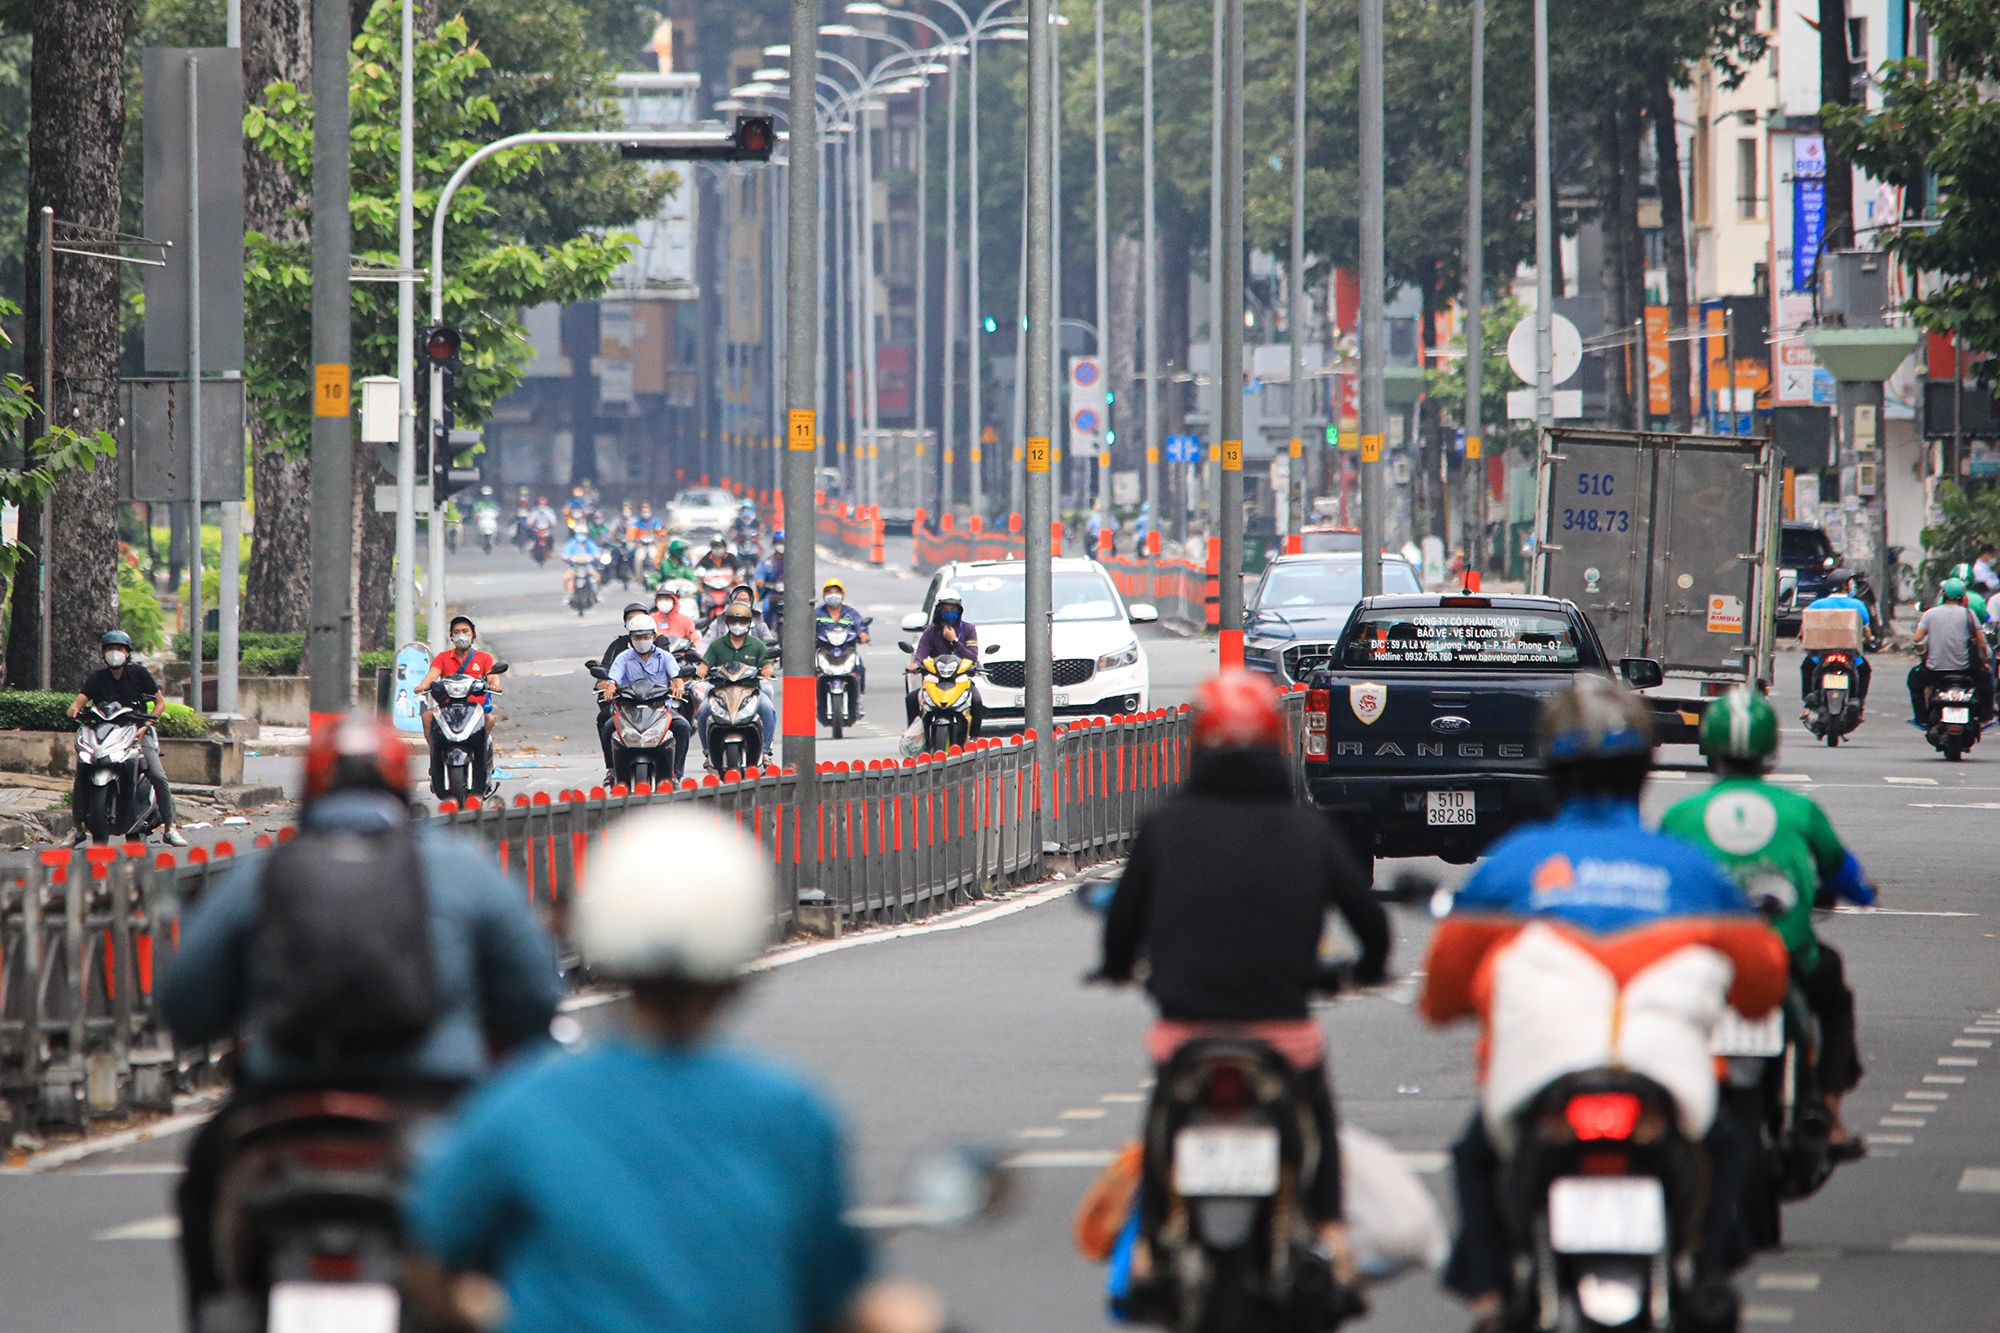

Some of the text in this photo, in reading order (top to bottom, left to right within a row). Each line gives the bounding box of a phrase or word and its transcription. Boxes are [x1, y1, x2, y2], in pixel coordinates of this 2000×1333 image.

[323, 383, 342, 400] 10
[796, 424, 810, 437] 11
[1031, 449, 1044, 460] 12
[1365, 444, 1375, 453] 14
[1227, 450, 1238, 461] 13
[1577, 473, 1615, 496] 51C
[1562, 508, 1629, 533] 348.73
[1413, 615, 1437, 626] CÔNG
[1438, 617, 1449, 626] TY
[1487, 617, 1507, 628] DỊCH
[1436, 627, 1447, 639] VỆ
[1453, 627, 1464, 639] VỆ
[1475, 628, 1498, 638] LONG
[1498, 627, 1516, 638] TÂN
[1371, 640, 1385, 649] Đ/C
[1391, 640, 1400, 649] 59
[1401, 640, 1408, 649] A
[1409, 640, 1418, 649] Lê
[1518, 641, 1542, 652] Phong
[1374, 651, 1403, 661] Hotline:
[1405, 652, 1453, 661] 0932.796.760
[1458, 652, 1558, 663] www.baovelongtan.com.vn
[1338, 742, 1542, 757] RANGE
[1438, 793, 1464, 807] 51D
[1429, 808, 1474, 823] 382.86
